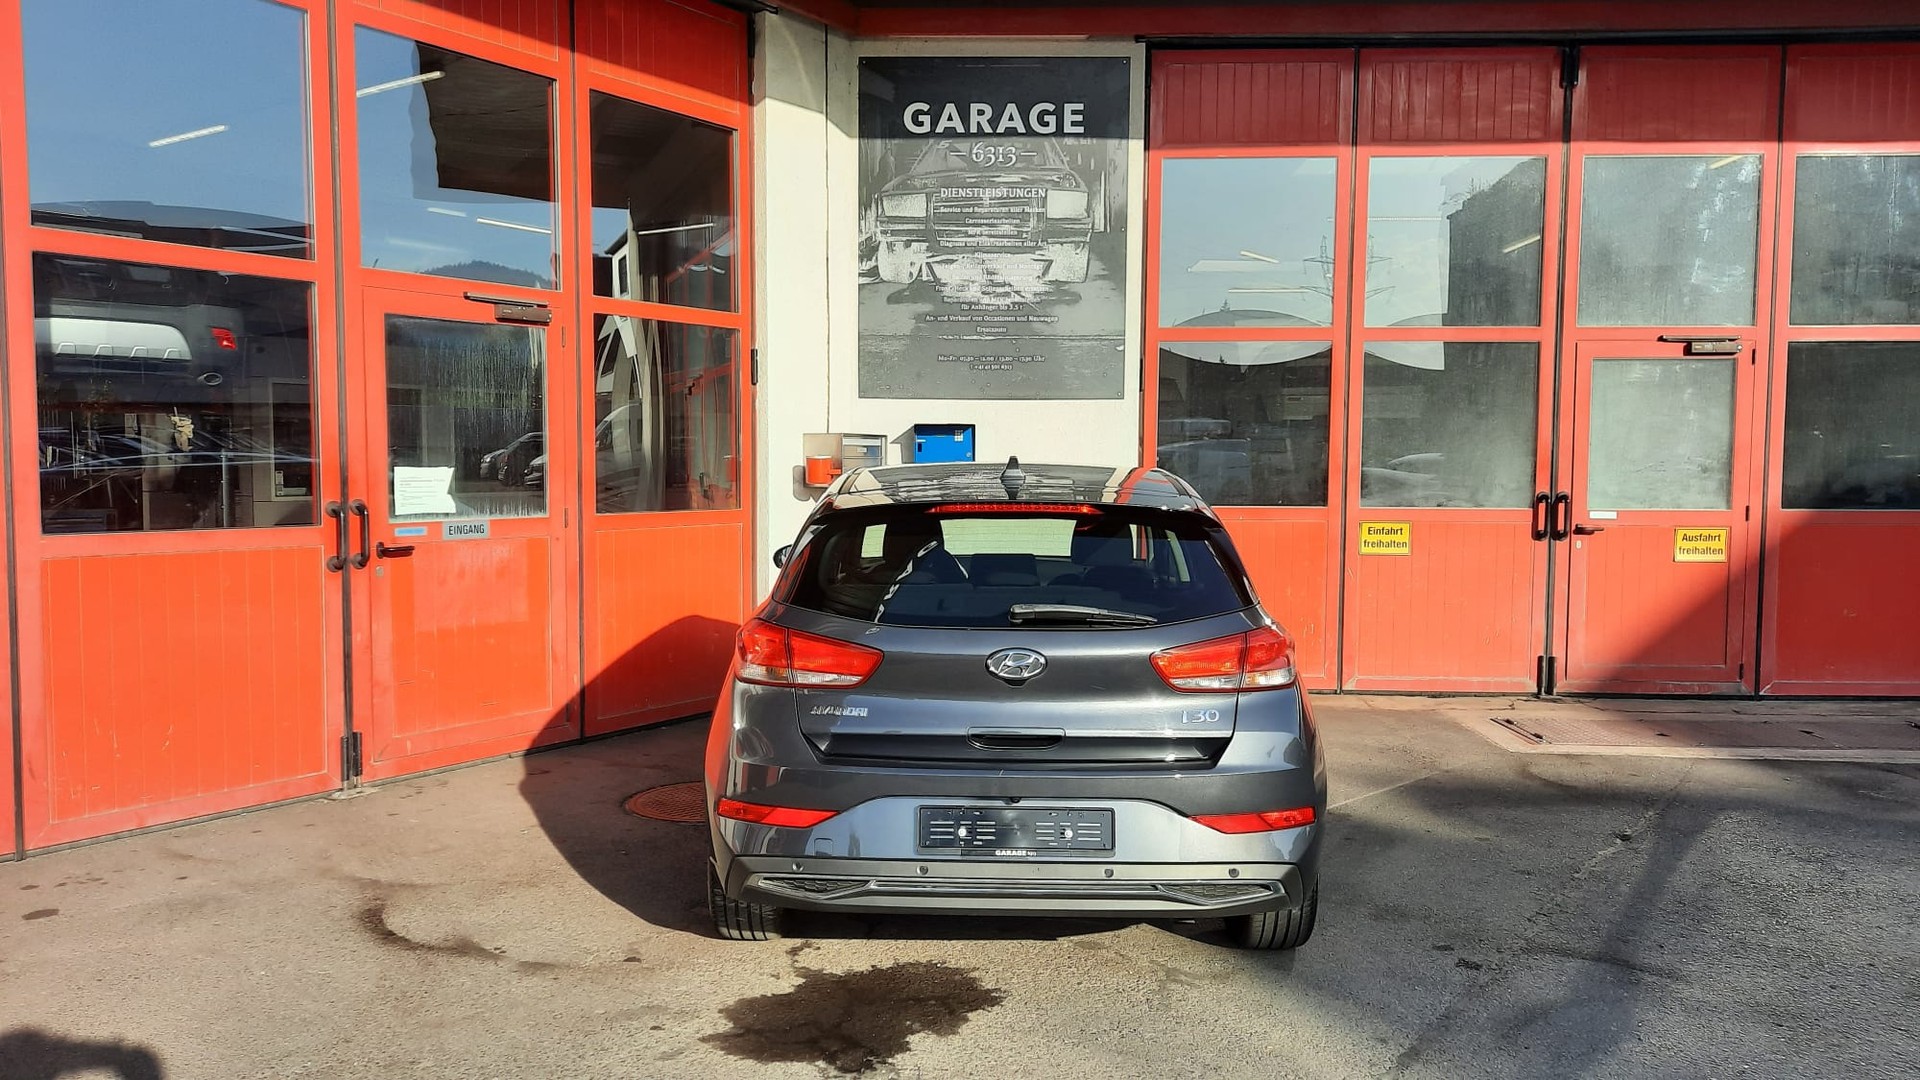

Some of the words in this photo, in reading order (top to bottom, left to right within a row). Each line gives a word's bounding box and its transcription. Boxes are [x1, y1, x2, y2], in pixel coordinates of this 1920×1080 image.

[903, 102, 1085, 135] GARAGE
[972, 142, 1017, 167] 6313
[940, 188, 1046, 198] DIENSTLEISTUNGEN
[971, 303, 998, 311] Anhänger
[448, 524, 485, 536] EINGANG
[1367, 526, 1403, 535] Einfahrt
[1681, 533, 1721, 542] Ausfahrt
[1363, 539, 1408, 548] freihalten
[1678, 546, 1724, 555] freihalten
[810, 705, 869, 717] HYUNDAI
